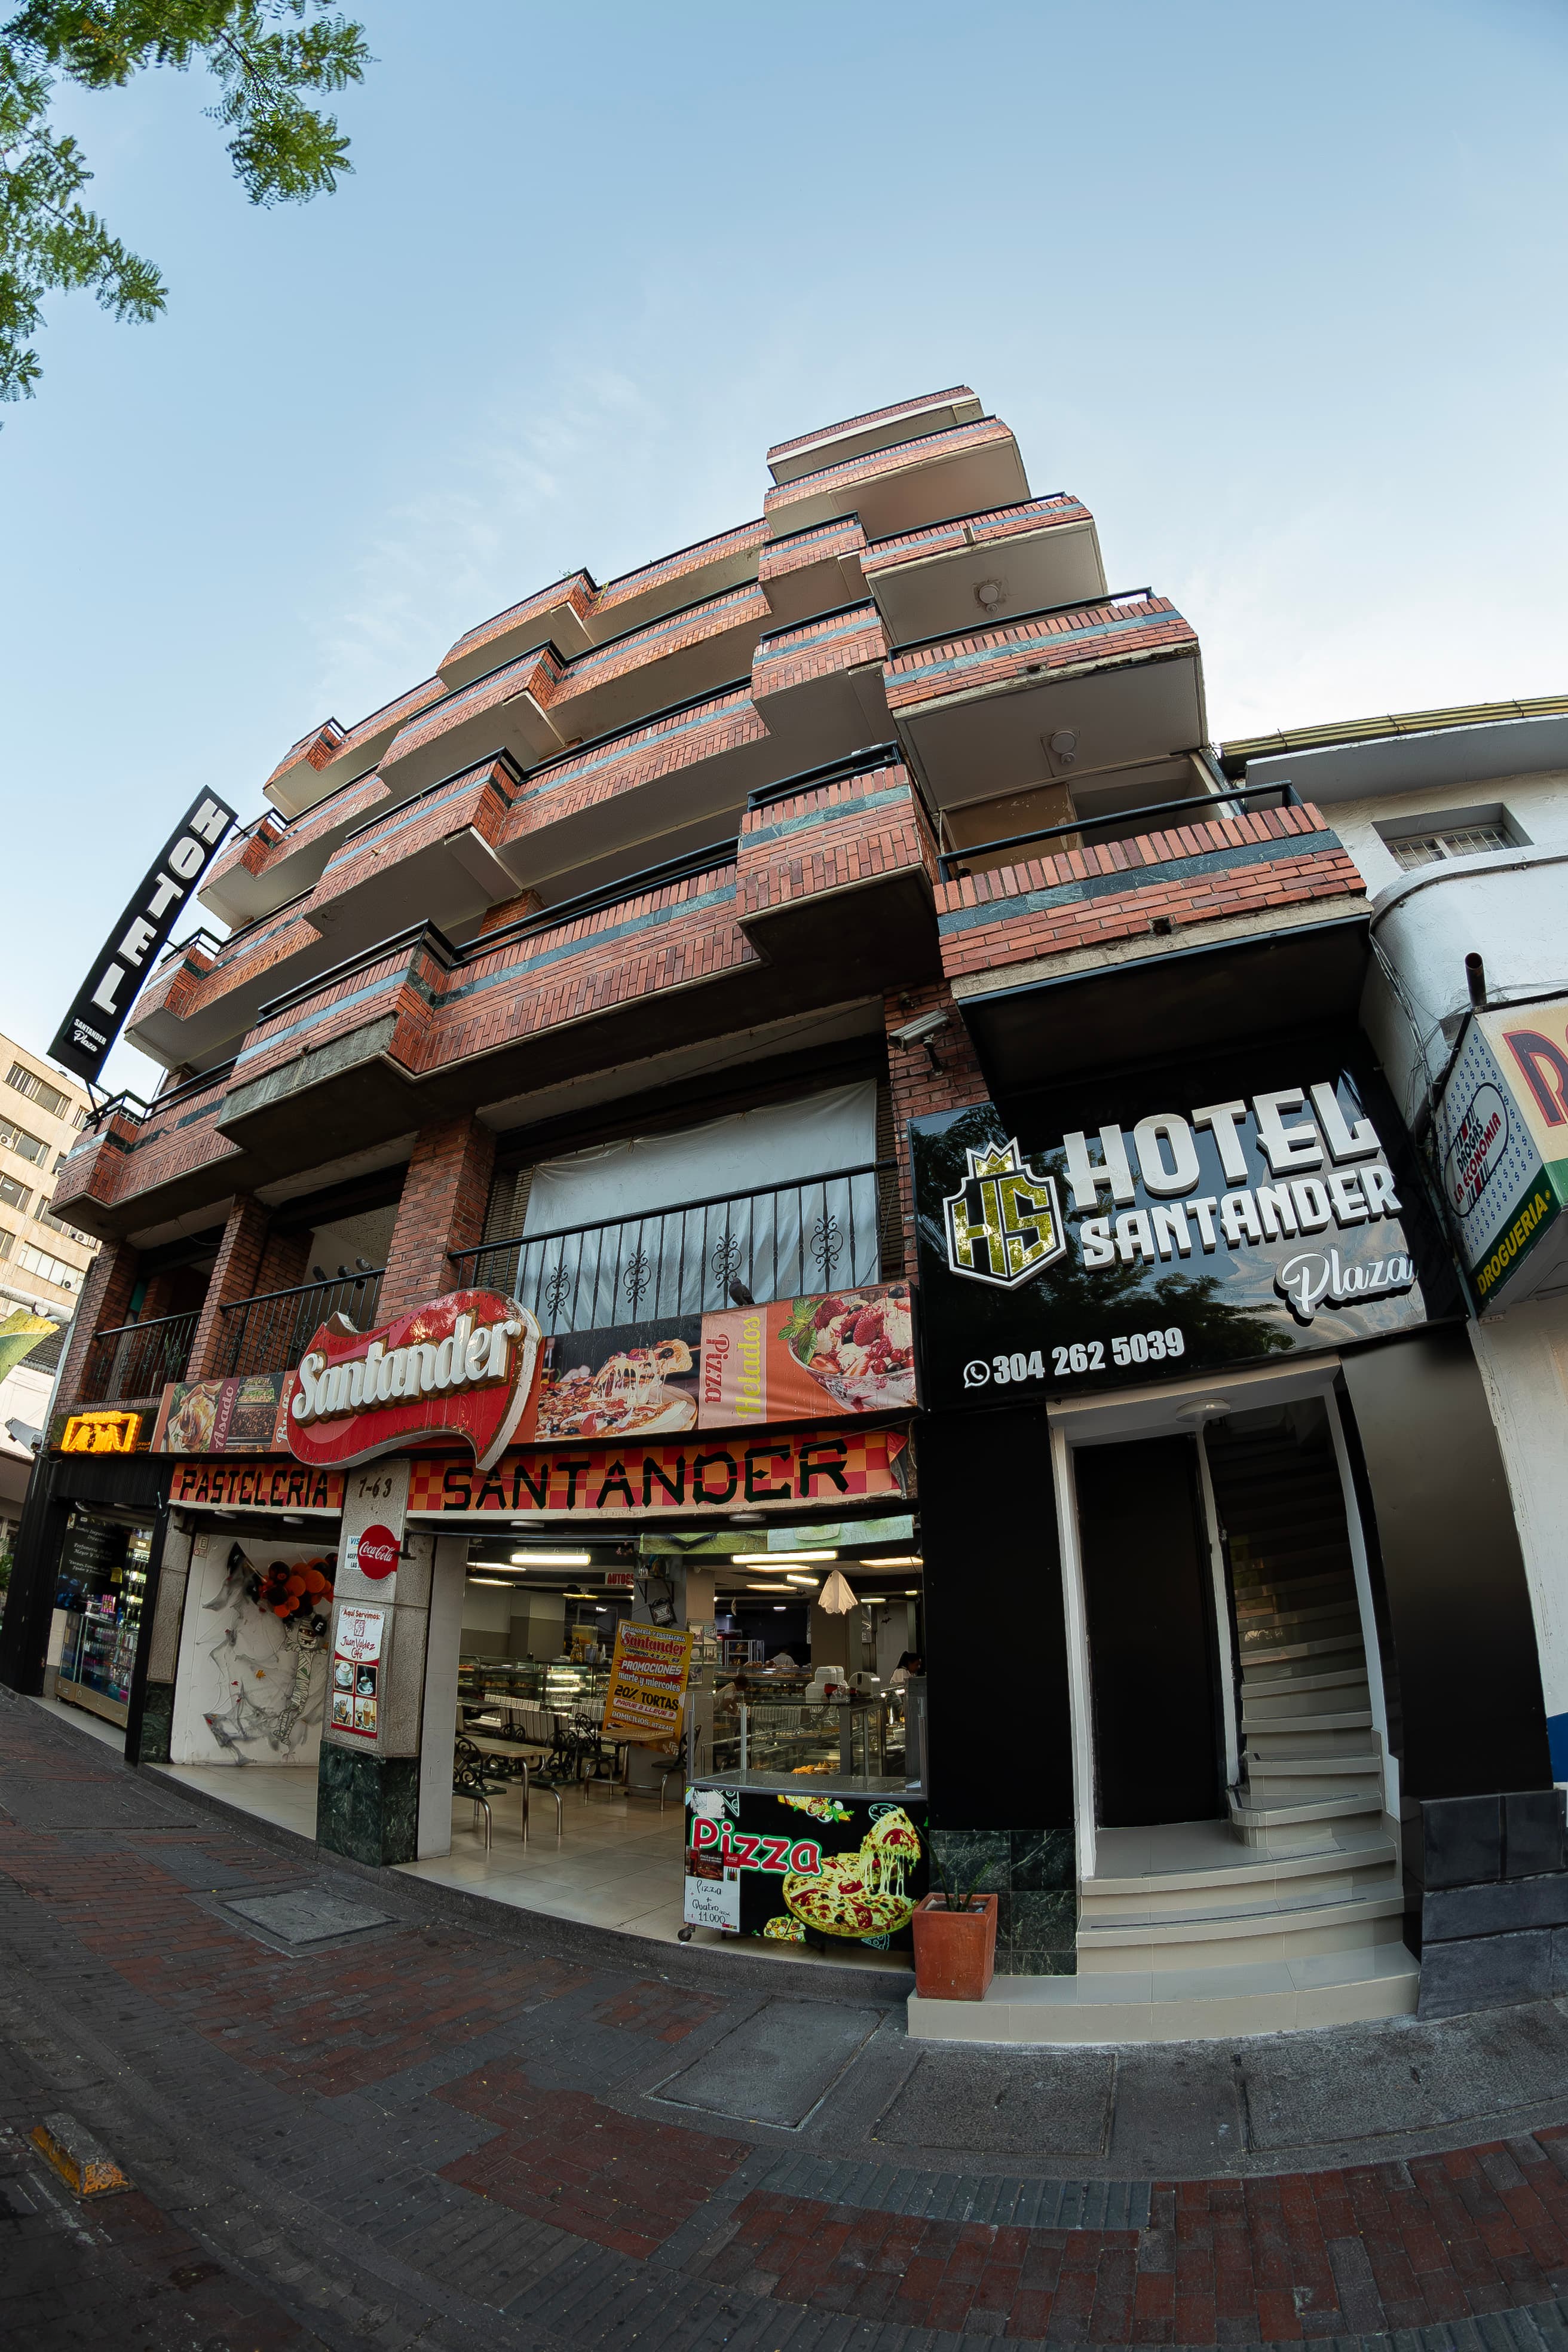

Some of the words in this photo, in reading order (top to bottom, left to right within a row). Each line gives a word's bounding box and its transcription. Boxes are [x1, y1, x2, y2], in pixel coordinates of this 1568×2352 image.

[91, 798, 229, 1015] HOTEL
[74, 1018, 107, 1045] SANTANDER
[74, 1030, 98, 1052] Plaza
[1062, 1082, 1382, 1212] HOTEL
[1453, 1184, 1465, 1205] LA
[1463, 1111, 1502, 1186] ECONOMIA
[1456, 1116, 1484, 1175] DROGAS
[1080, 1164, 1403, 1271] SANTANDER
[1477, 1192, 1549, 1296] DROGUERIA
[1280, 1247, 1414, 1315] Plaza
[291, 1312, 523, 1420] Santander
[705, 1333, 730, 1404] Pizza
[734, 1315, 761, 1419] Helados
[993, 1353, 1045, 1385] 304
[1052, 1340, 1106, 1376] 262
[1111, 1327, 1186, 1367] 5039
[215, 1385, 235, 1450] Asado
[180, 1469, 328, 1508] PASTELERIA
[443, 1439, 851, 1512] SANTANDER
[350, 1537, 360, 1545] VIS
[355, 1610, 381, 1621] Servimos:
[340, 1635, 356, 1648] Juan
[355, 1637, 376, 1651] Valdez
[351, 1647, 363, 1659] Café
[620, 1632, 687, 1656] Santander
[618, 1672, 638, 1683] marte
[639, 1676, 645, 1687] y
[645, 1678, 681, 1693] miercoles
[621, 1659, 684, 1676] PROMOCIONES
[614, 1684, 640, 1701] 20%
[641, 1691, 679, 1711] TORTAS
[615, 1699, 638, 1710] PAGUE
[645, 1705, 667, 1717] LLEVE
[611, 1710, 651, 1726] DOMICILIOS:
[691, 1815, 822, 1876] Pizza
[691, 1898, 719, 1912] Quatro
[696, 1879, 722, 1896] Pizza
